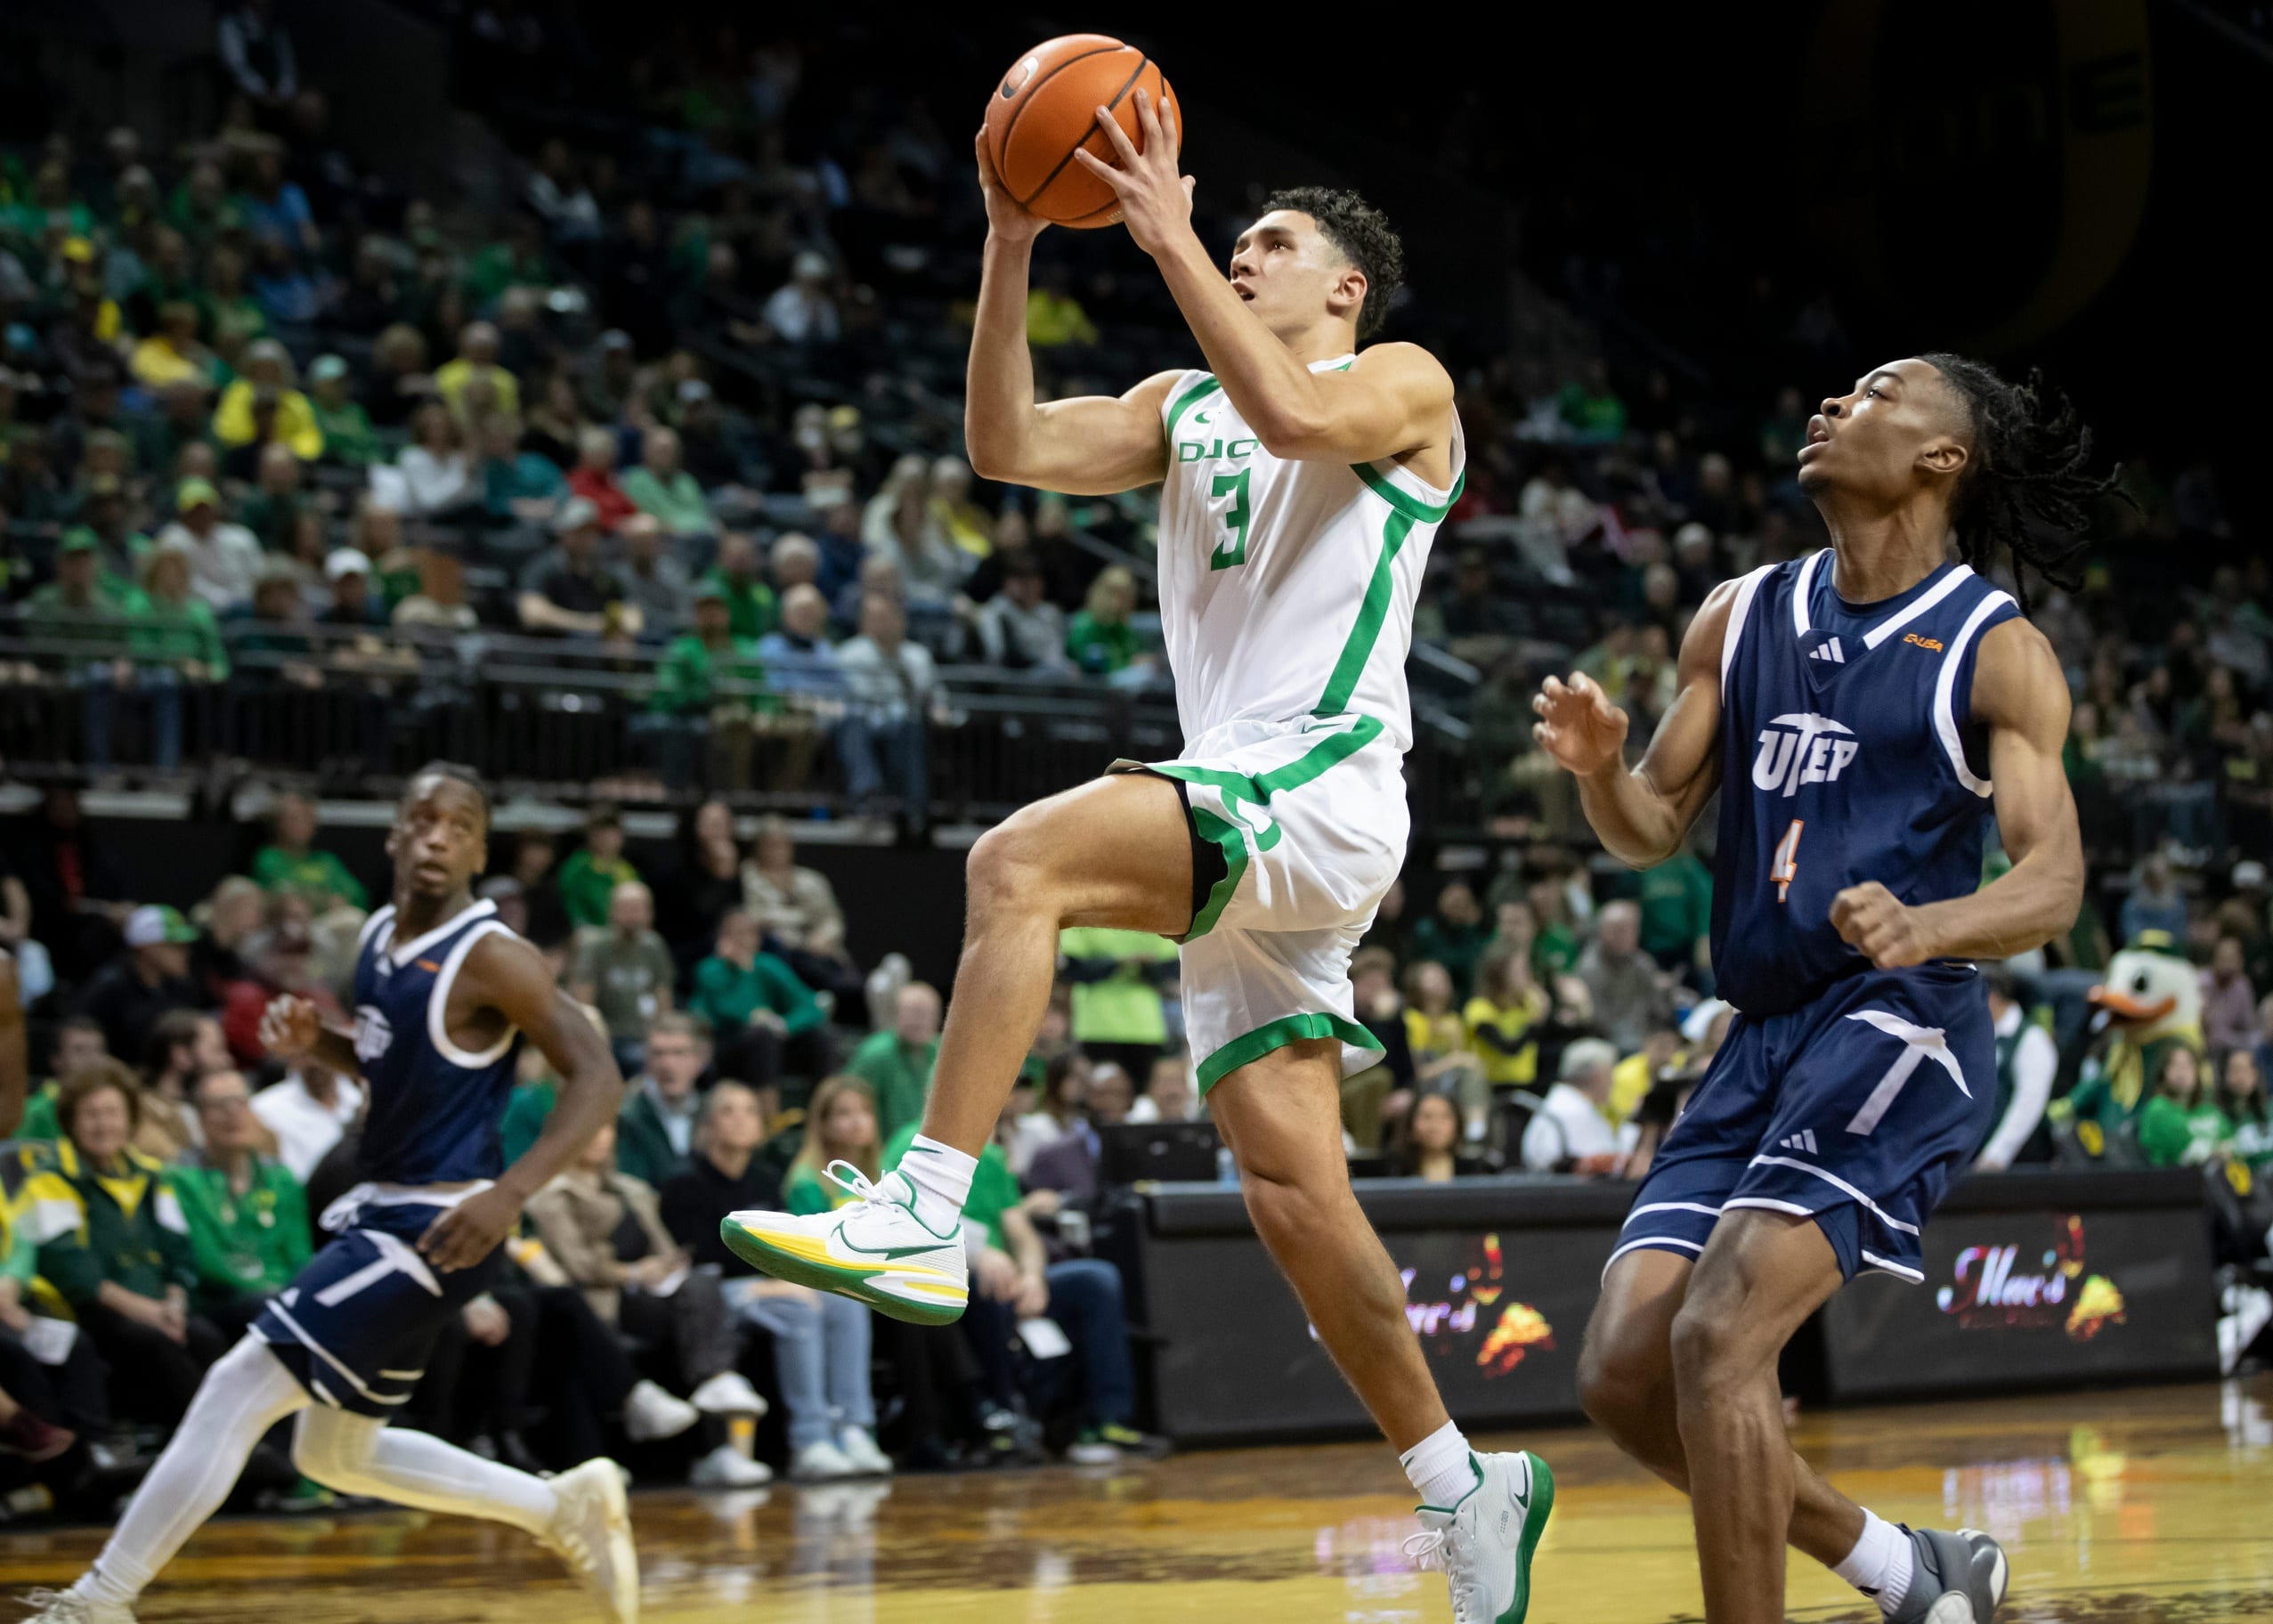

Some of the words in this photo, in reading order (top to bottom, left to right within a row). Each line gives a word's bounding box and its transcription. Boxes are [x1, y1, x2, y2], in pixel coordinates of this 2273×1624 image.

[1179, 439, 1260, 462] DUC
[1211, 467, 1251, 572] 3
[1752, 712, 1860, 798] UTEP
[1769, 818, 1805, 903] 4
